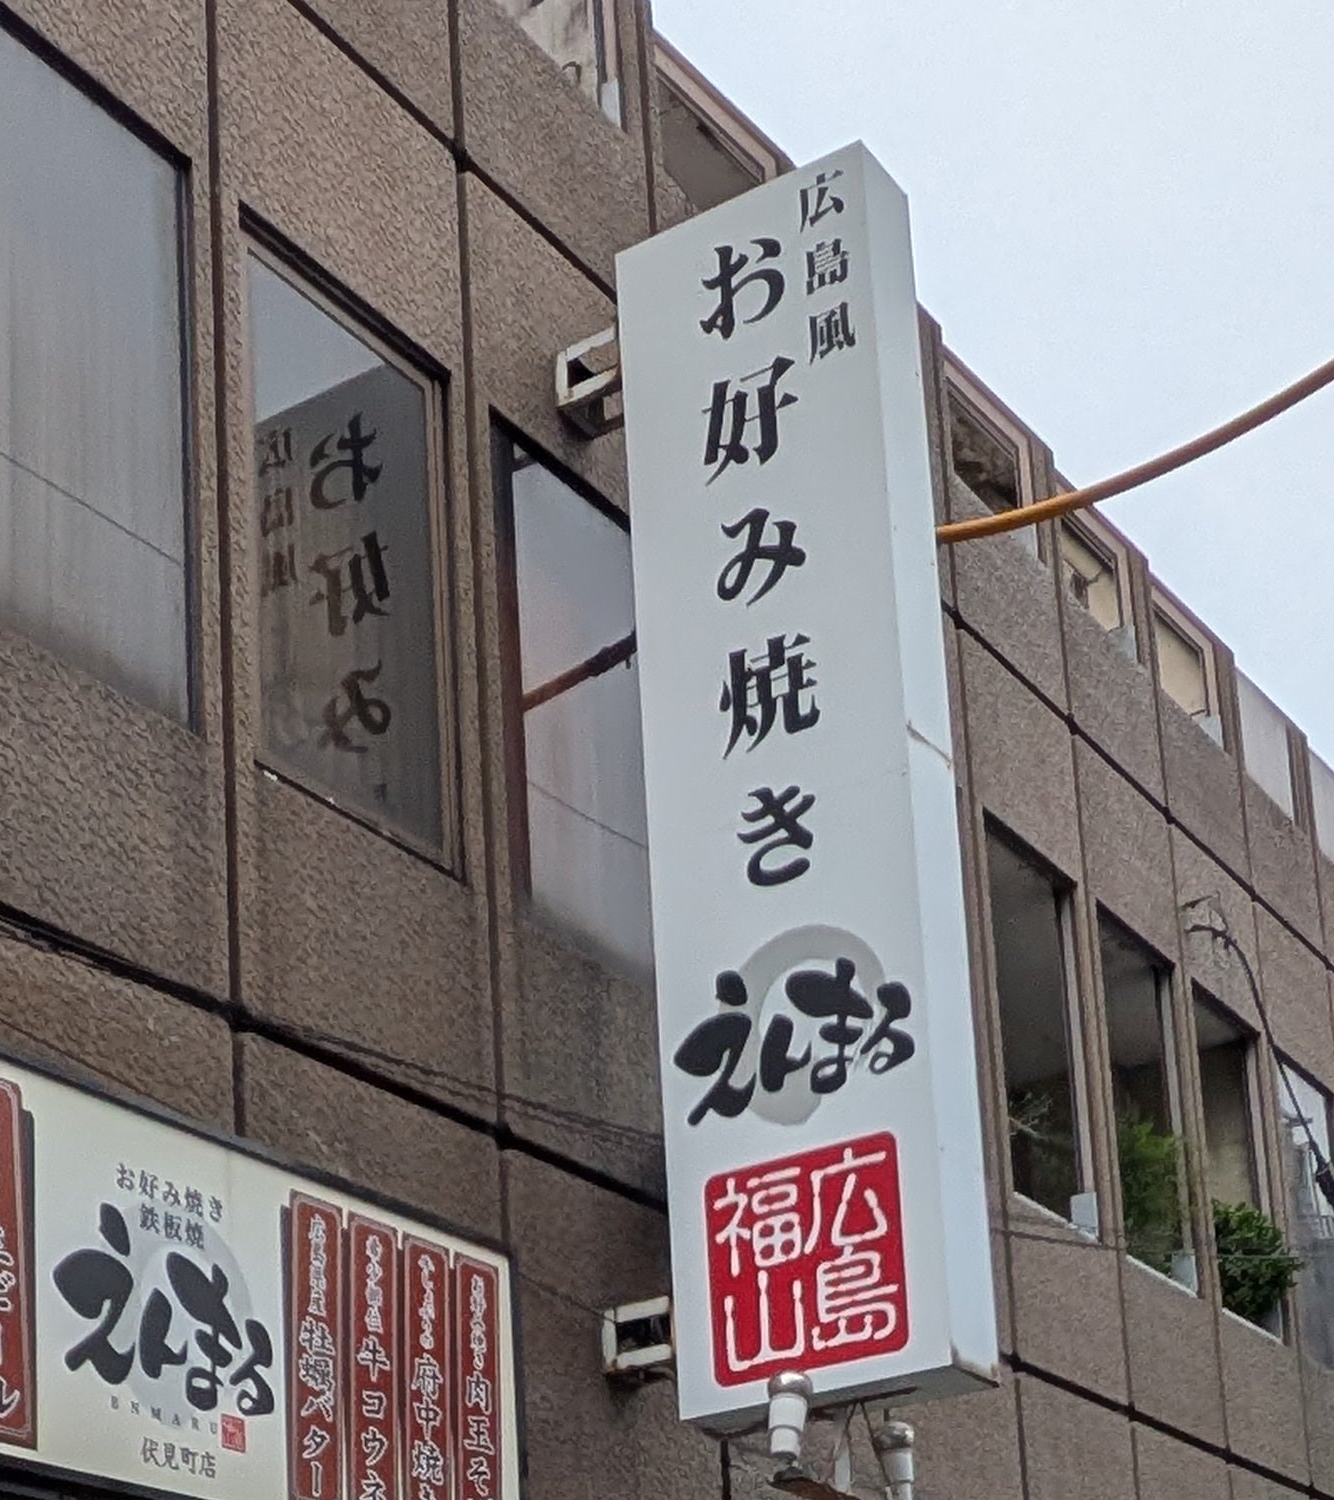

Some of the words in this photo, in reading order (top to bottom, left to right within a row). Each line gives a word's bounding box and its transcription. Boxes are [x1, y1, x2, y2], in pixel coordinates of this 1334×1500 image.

[799, 170, 856, 366] 広島風
[699, 238, 820, 888] お好み焼き
[673, 957, 916, 1127] えんまる
[115, 1162, 224, 1223] お好み焼き
[139, 1202, 205, 1251] 鉄板焼
[52, 1202, 275, 1417] えんまる
[140, 1436, 217, 1479] 伏見町店
